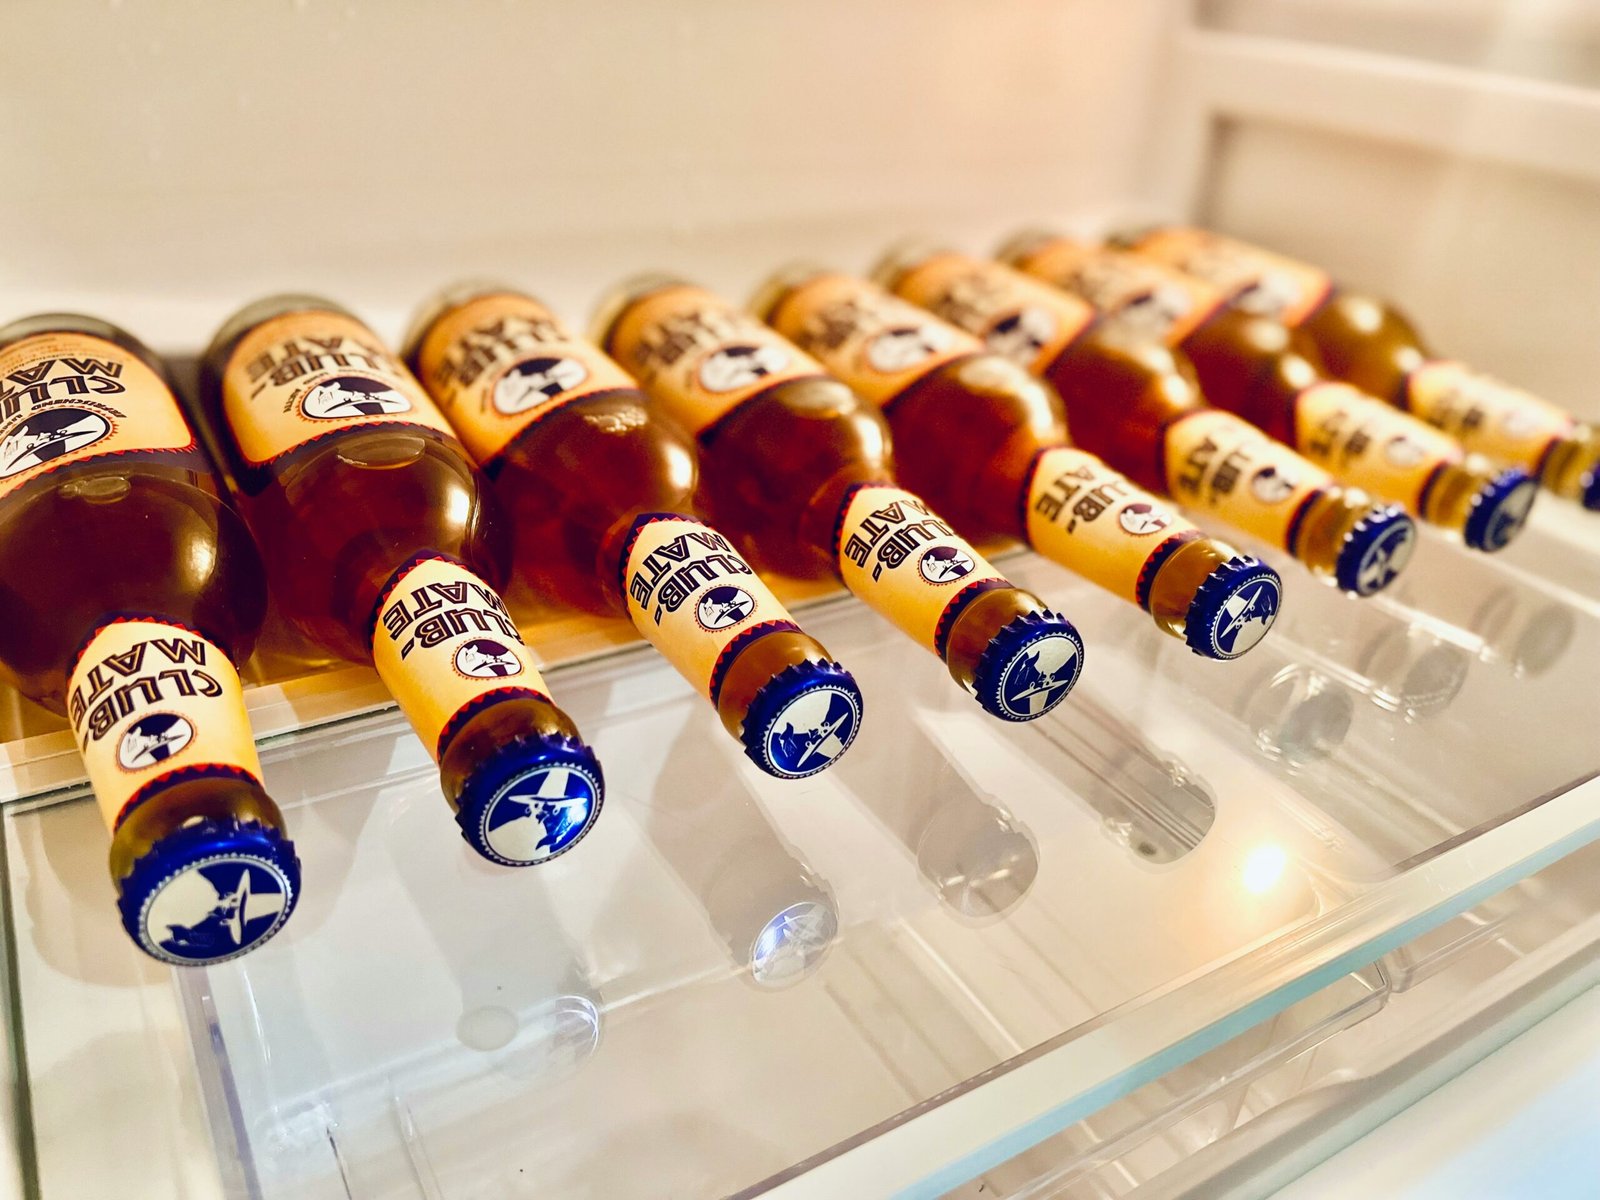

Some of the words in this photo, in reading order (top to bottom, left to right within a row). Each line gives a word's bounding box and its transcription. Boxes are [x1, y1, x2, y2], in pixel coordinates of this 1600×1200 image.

[0, 375, 126, 425] CLU
[1035, 465, 1095, 522] ATE
[629, 532, 731, 610] MATE
[871, 519, 954, 583] LUB-
[383, 580, 510, 641] MATE
[71, 637, 206, 733] MATE
